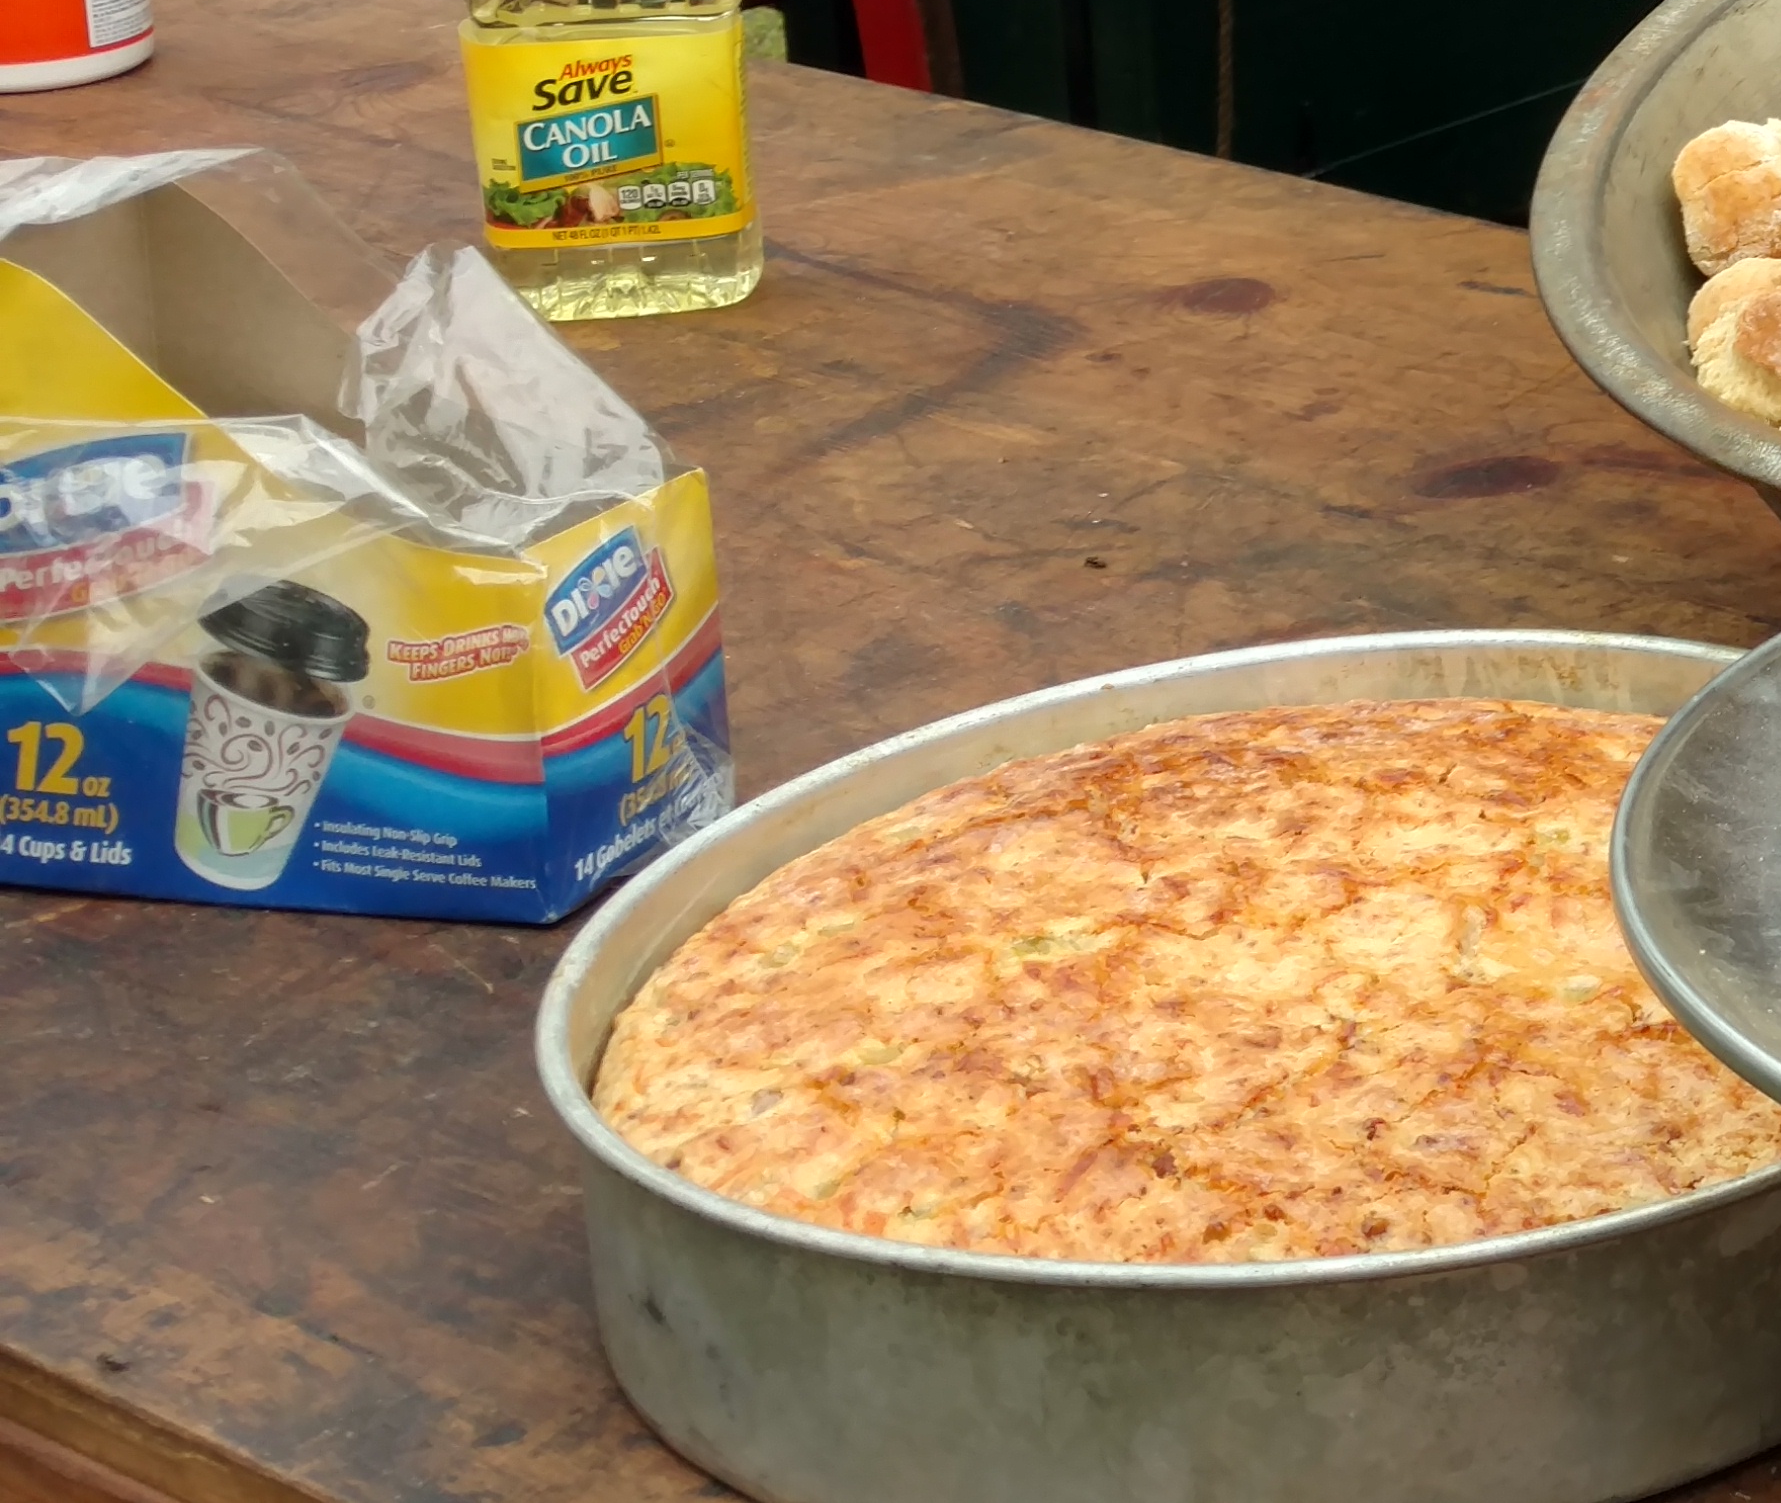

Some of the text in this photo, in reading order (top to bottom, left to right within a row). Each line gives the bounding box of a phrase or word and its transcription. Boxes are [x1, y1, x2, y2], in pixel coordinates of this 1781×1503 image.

[559, 54, 633, 81] Always
[532, 70, 633, 111] Save
[523, 105, 652, 151] CANOLA
[562, 141, 618, 169] OIL
[552, 231, 568, 240] NET
[388, 642, 438, 660] KEEPS
[443, 630, 500, 657] DRINKS
[412, 653, 475, 678] FINGERS
[623, 693, 671, 783] 12
[7, 720, 111, 798] 12 oz
[73, 802, 119, 835] mL)
[322, 820, 458, 848] Insulating Non-Slip Grip
[18, 835, 67, 864] Cups
[69, 840, 87, 862] &
[89, 840, 133, 866] Lids
[321, 840, 482, 867] Includes Leak-Resistant Lids
[574, 852, 594, 881] 14
[596, 817, 657, 870] Gobelets
[320, 859, 537, 890] Fits Most Single Serve Coffee Makers
